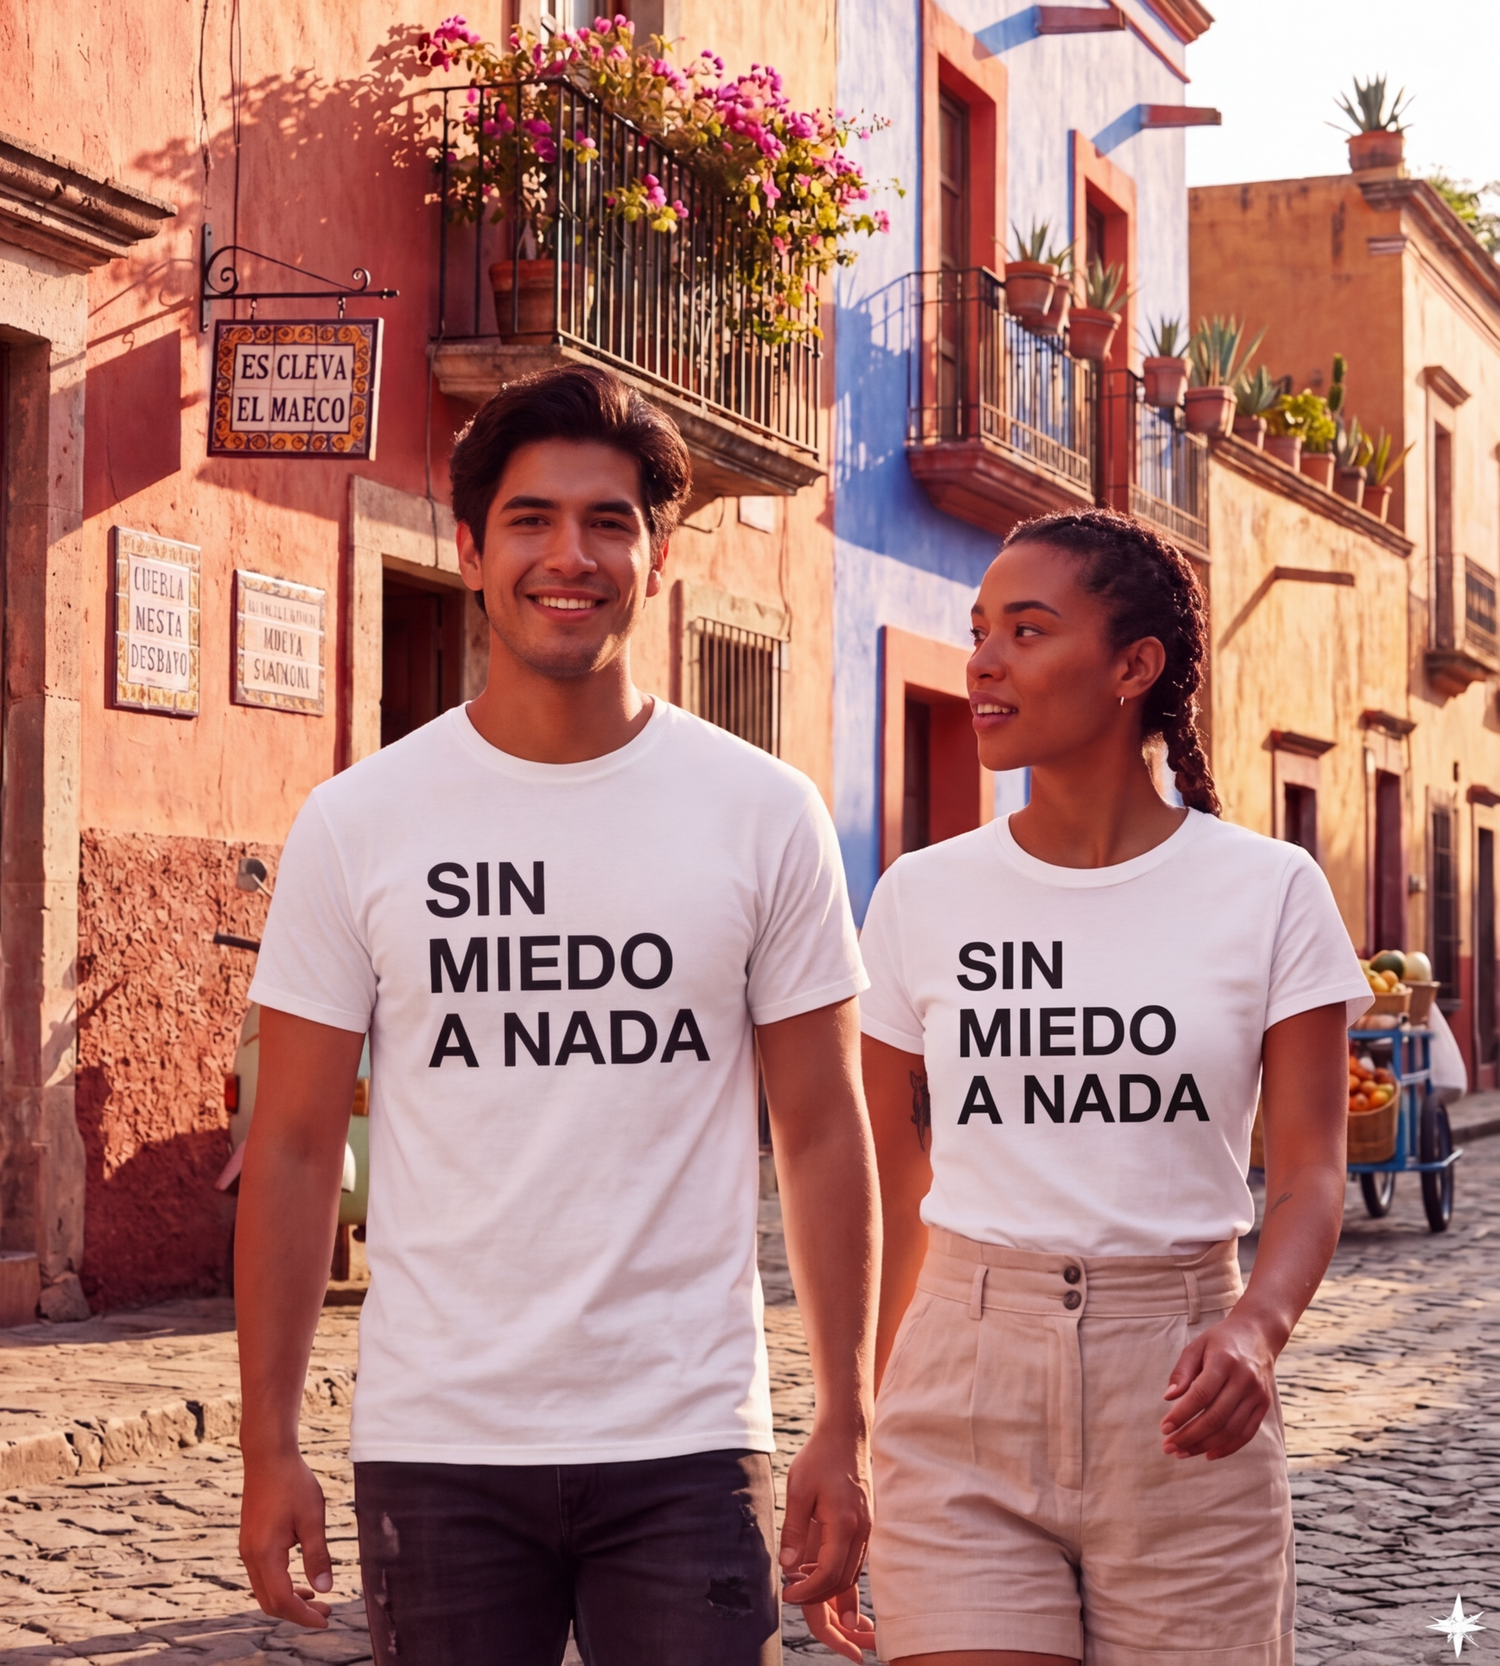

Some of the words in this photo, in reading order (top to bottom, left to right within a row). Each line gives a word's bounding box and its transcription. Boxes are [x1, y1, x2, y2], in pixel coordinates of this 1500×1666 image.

[241, 354, 269, 380] ES
[277, 354, 347, 380] CLEVA
[236, 396, 264, 422] EL
[270, 397, 345, 423] MAECO
[425, 860, 545, 919] SIN
[429, 932, 674, 994] MIEDO
[956, 940, 1063, 992] SIN
[428, 1013, 480, 1068] A
[503, 1008, 711, 1067] NADA
[959, 1004, 1177, 1058] MIEDO
[956, 1075, 1003, 1125] A
[1023, 1073, 1211, 1125] NADA
